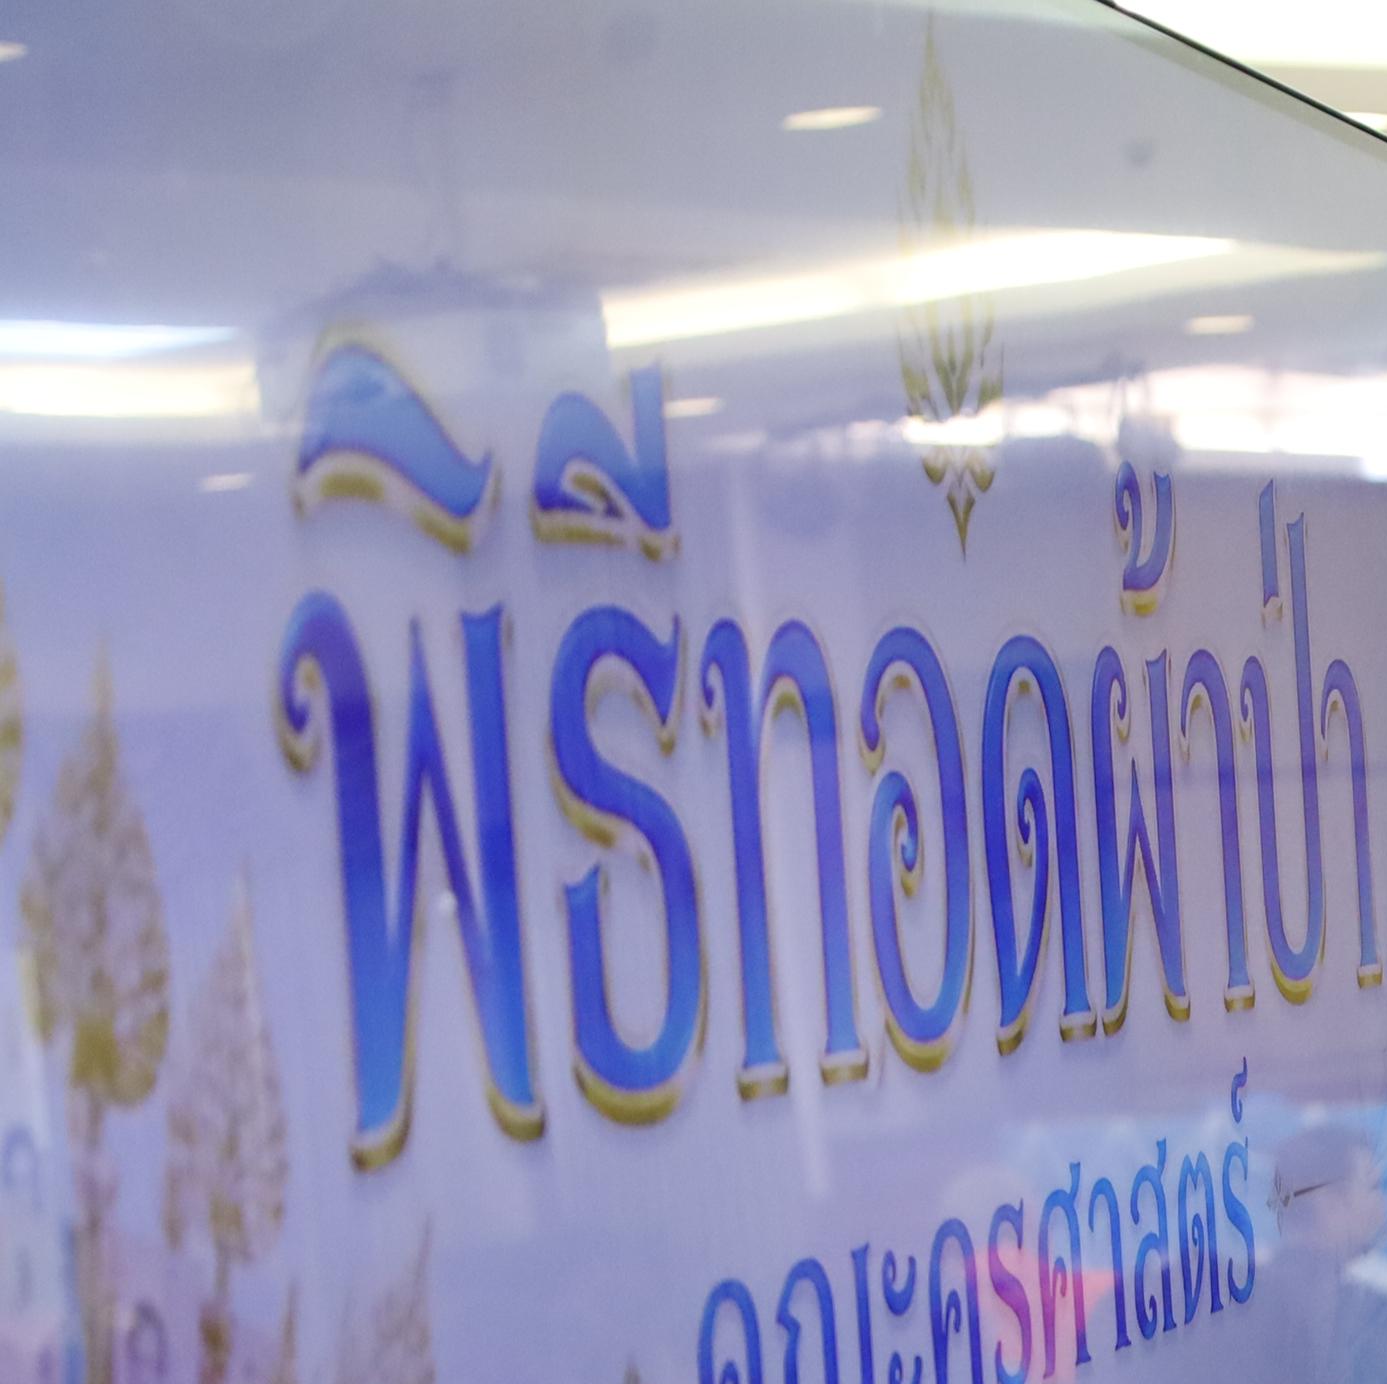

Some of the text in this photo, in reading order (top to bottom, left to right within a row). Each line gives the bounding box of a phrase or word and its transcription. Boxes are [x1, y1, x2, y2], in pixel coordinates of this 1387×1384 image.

[275, 322, 1384, 1174] พิธีทอดผ้าป่า
